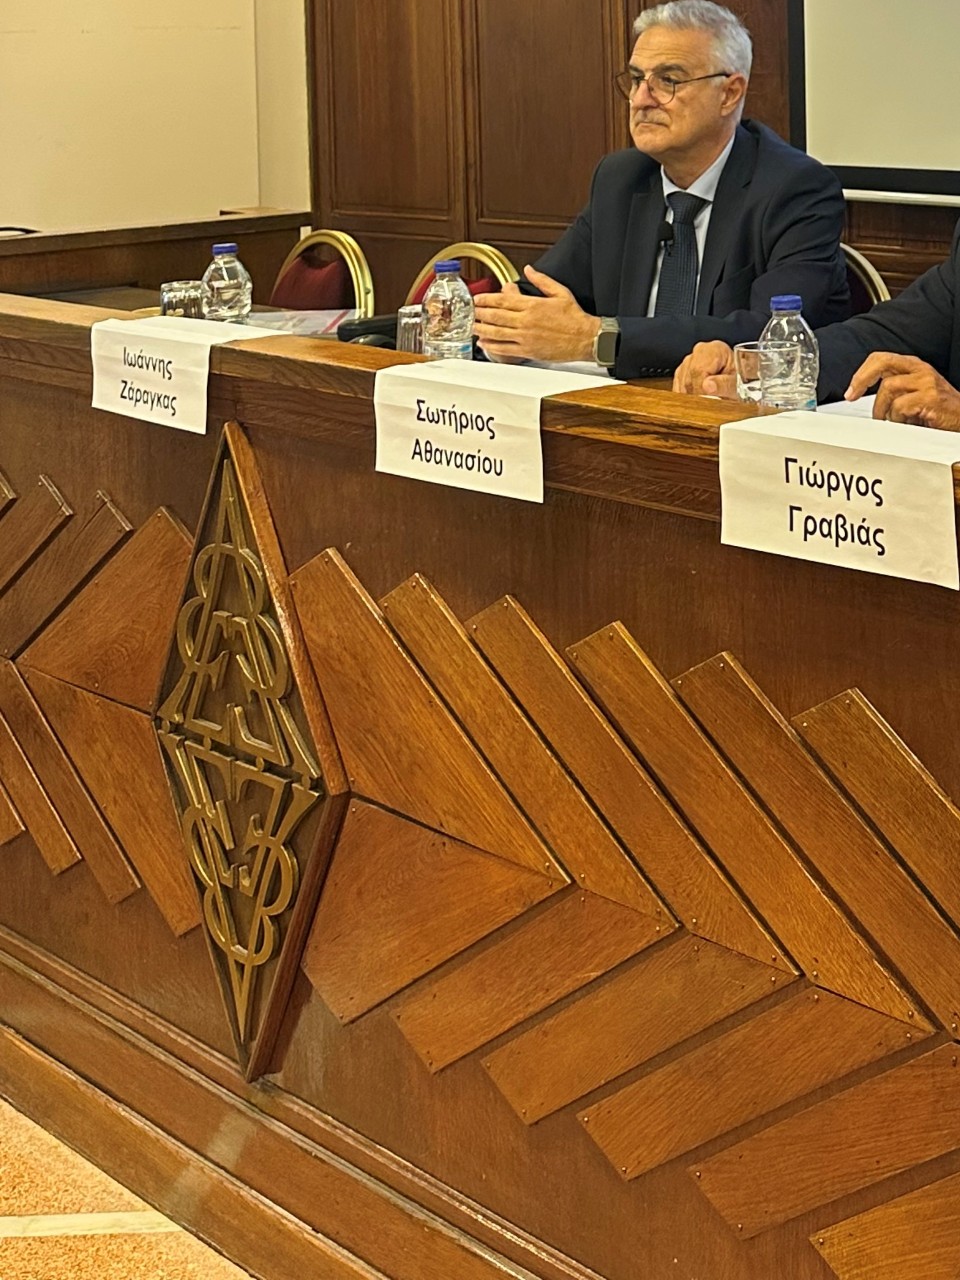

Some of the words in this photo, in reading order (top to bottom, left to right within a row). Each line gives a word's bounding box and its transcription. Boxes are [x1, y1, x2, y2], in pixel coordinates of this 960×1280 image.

[123, 346, 172, 380] Ιωάννης
[120, 380, 177, 417] Ζάραγκας
[416, 398, 495, 440] Σωτήριος
[411, 438, 504, 477] Αθανασίου
[784, 457, 883, 507] Γιώργος
[789, 505, 885, 556] Γραβιάς
